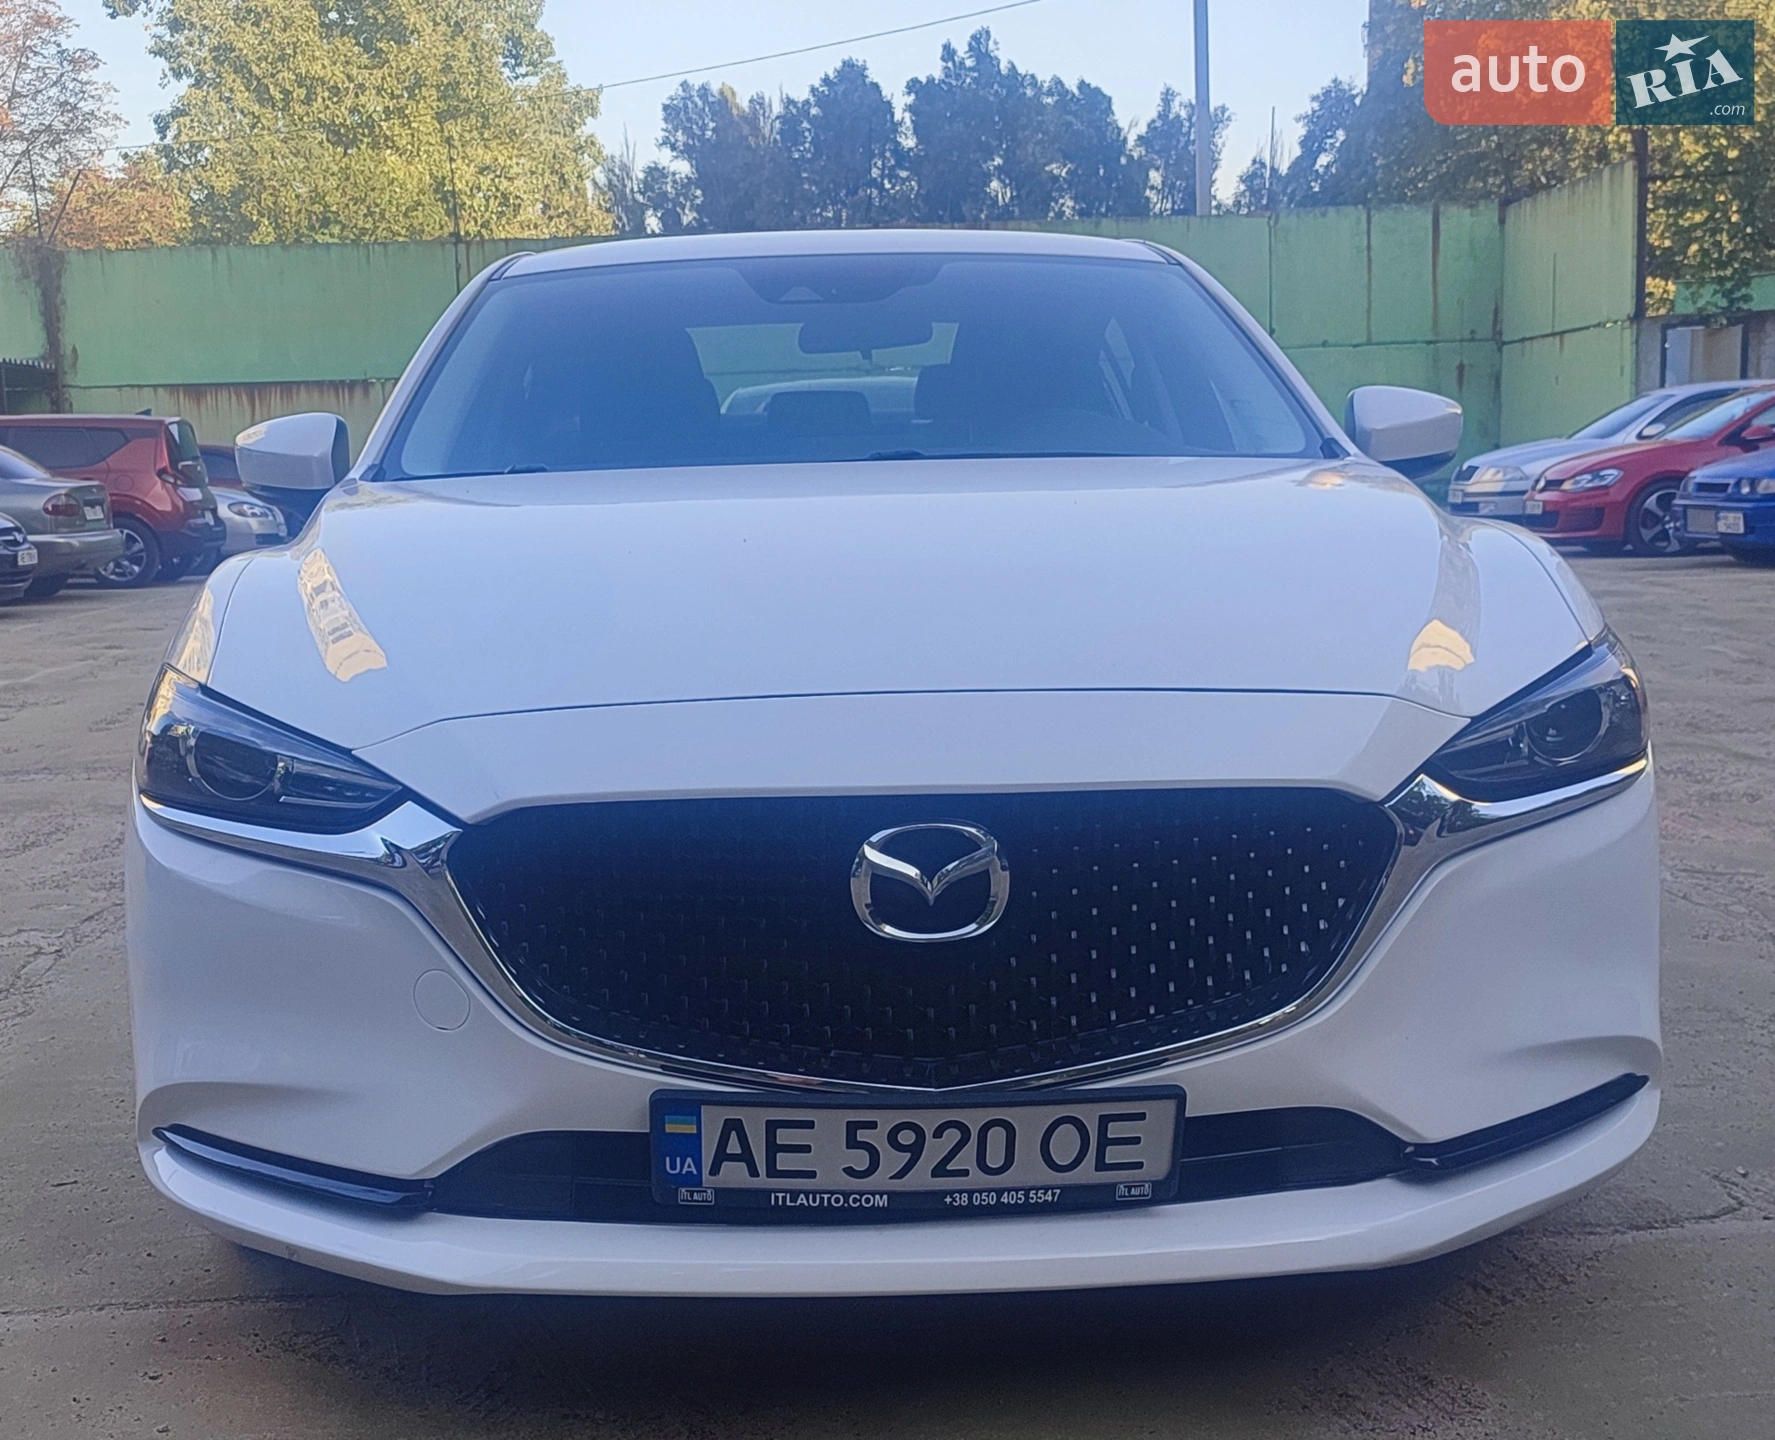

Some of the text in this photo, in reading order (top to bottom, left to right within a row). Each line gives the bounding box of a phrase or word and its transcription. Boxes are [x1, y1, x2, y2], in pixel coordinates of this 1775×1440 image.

[708, 1111, 1148, 1181] AE 5920 OE
[665, 1156, 698, 1176] UA
[770, 1192, 889, 1208] ITLAUTO.COM
[943, 1188, 1061, 1207] +38 050 405 5547
